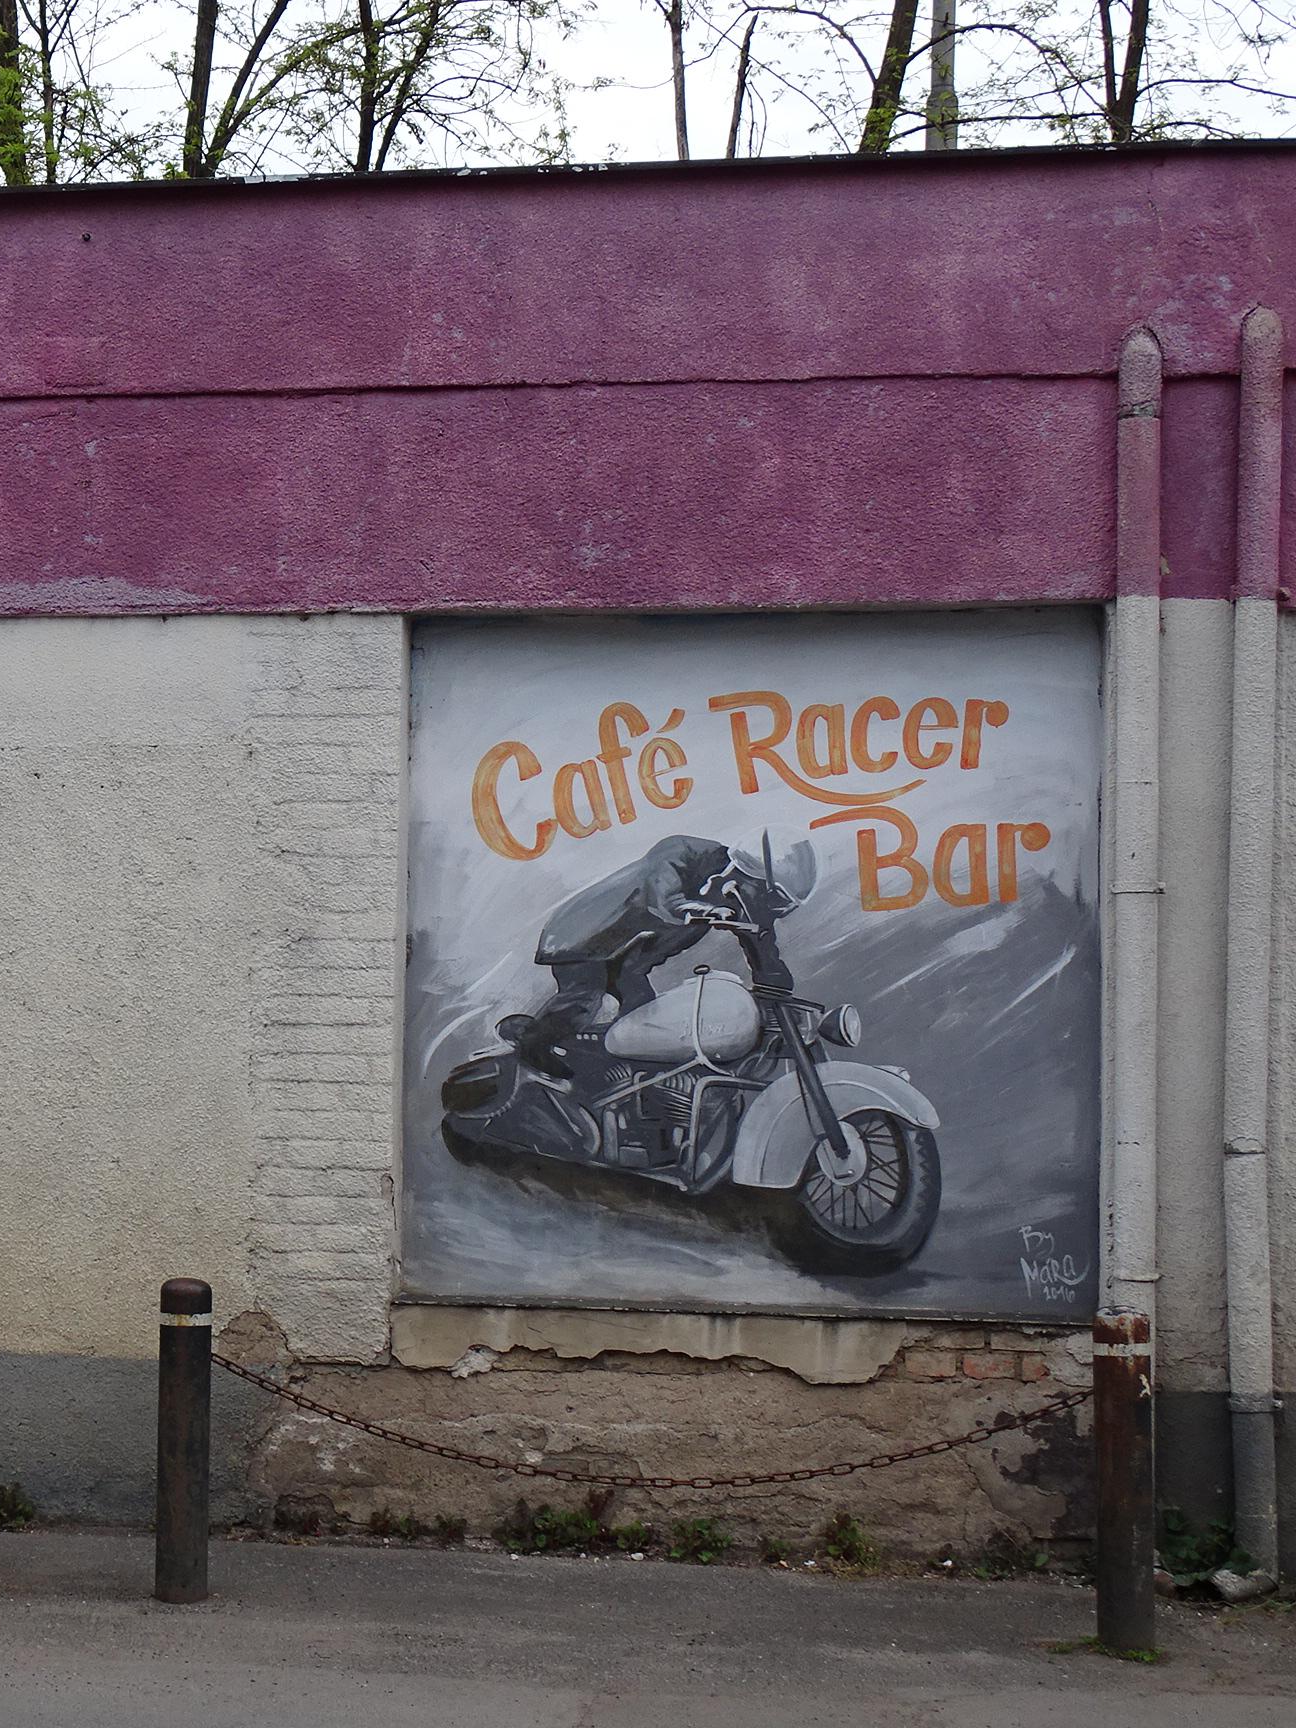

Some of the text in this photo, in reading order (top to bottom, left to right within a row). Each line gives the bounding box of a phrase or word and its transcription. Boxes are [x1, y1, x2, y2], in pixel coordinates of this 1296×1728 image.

[471, 691, 1009, 861] Café Racer
[809, 804, 1051, 912] Bar
